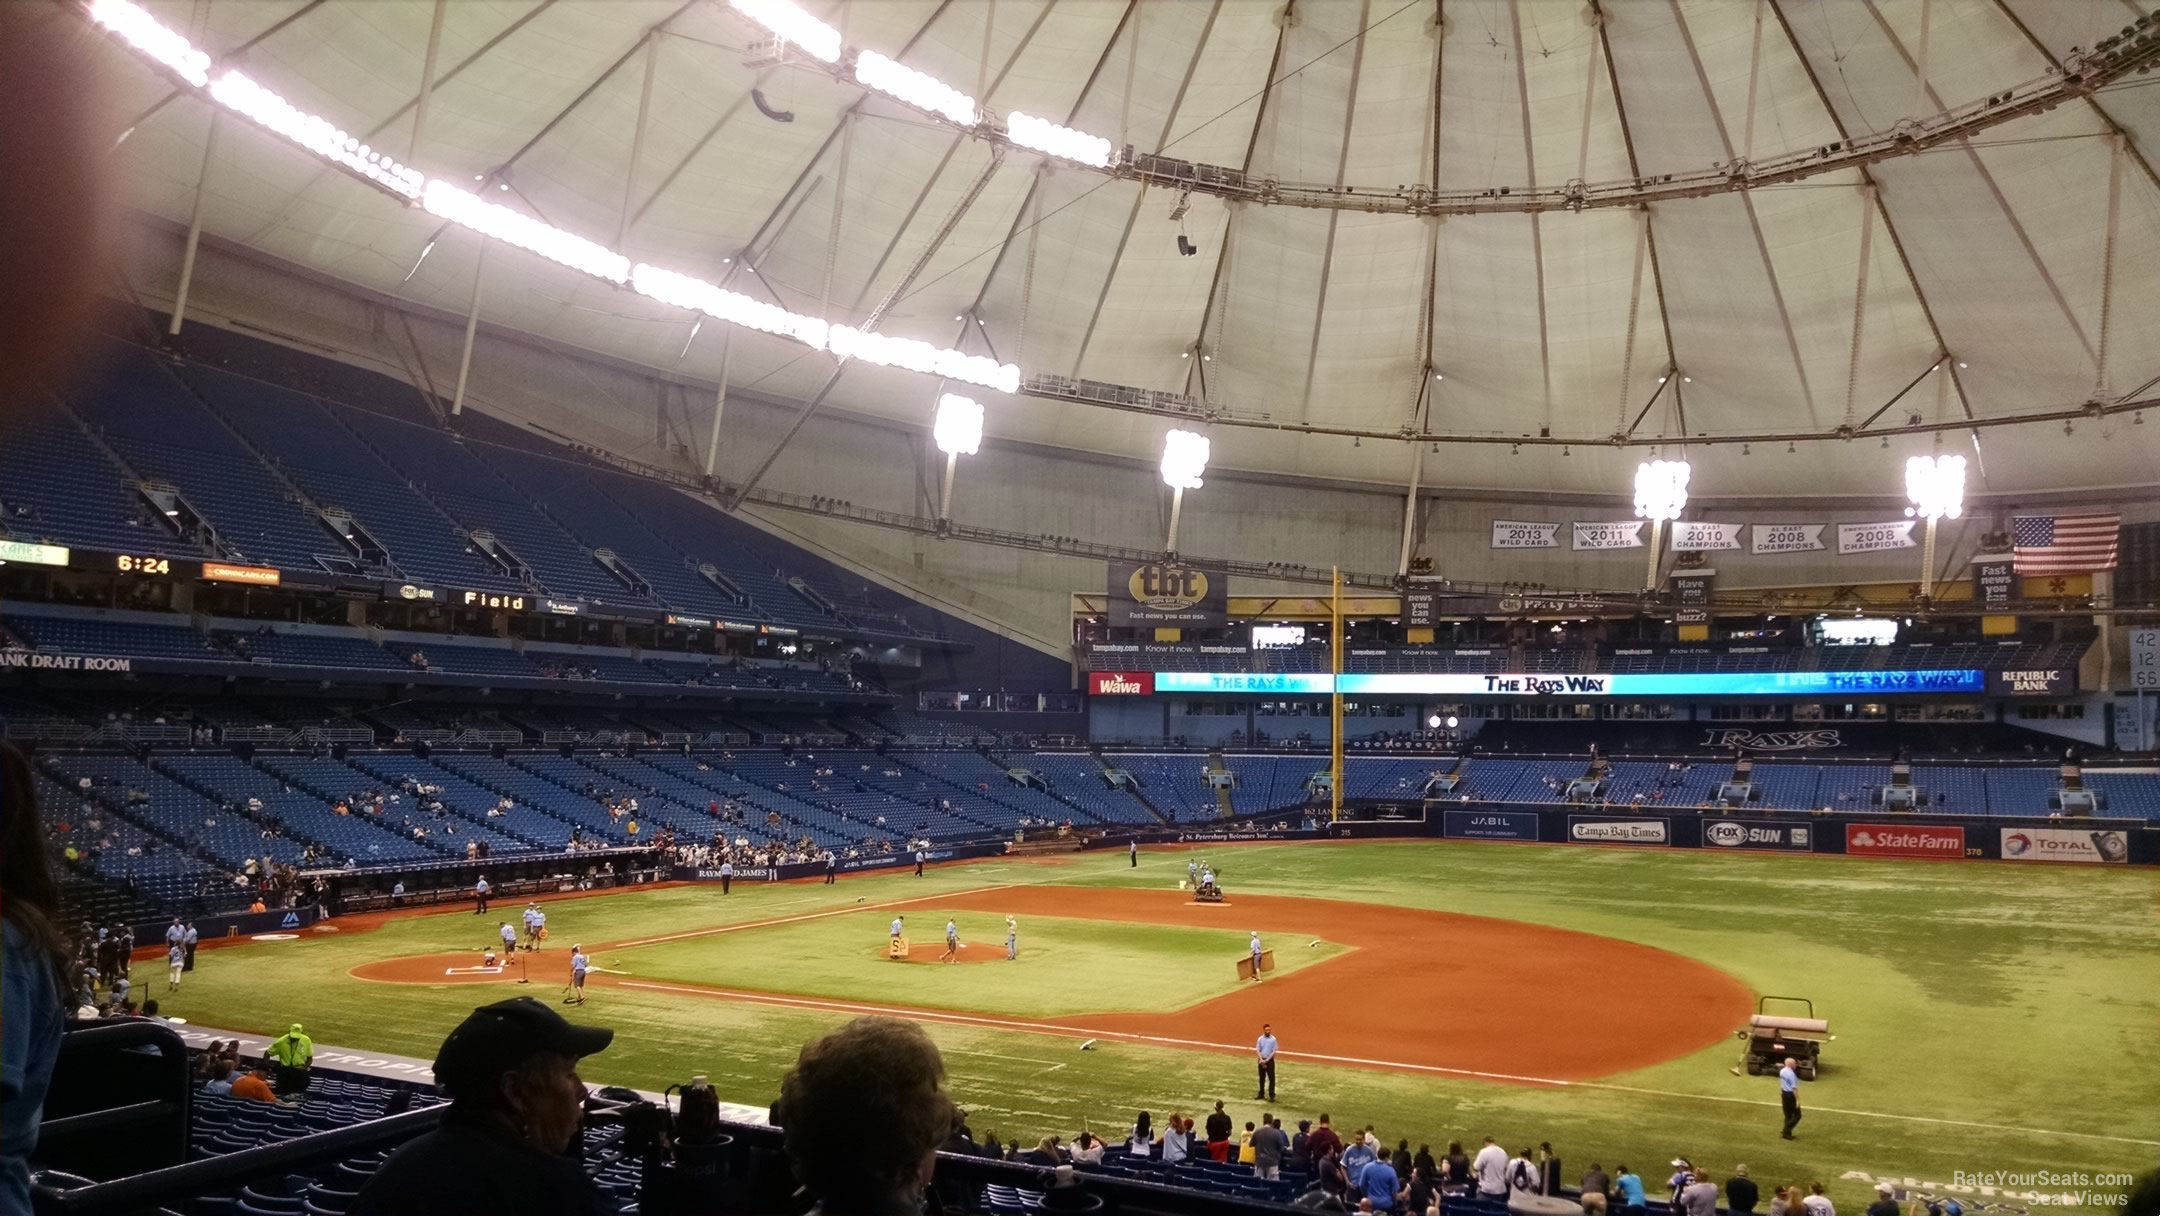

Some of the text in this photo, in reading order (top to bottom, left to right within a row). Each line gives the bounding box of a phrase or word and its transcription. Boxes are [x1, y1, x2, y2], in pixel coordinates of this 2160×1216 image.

[1509, 530, 1542, 540] 2013
[1591, 531, 1623, 540] 2011
[1687, 531, 1723, 541] 2010
[1768, 533, 1806, 543] 2008
[1855, 530, 1895, 543] 2008
[1844, 541, 1906, 550] CHAMPIONS
[118, 555, 170, 574] 6:24
[1982, 566, 2007, 575] Fast
[1140, 564, 1198, 597] tbt
[1678, 580, 1705, 588] Have
[1981, 576, 2012, 585] news
[419, 589, 434, 598] SUN
[1985, 585, 2008, 595] you
[465, 592, 523, 610] Field
[1411, 603, 1429, 611] you
[1676, 612, 1708, 622] buzz?
[2136, 633, 2156, 647] 42
[1093, 644, 1139, 652] tampabay.com
[1200, 645, 1247, 654] tampabay.com
[31, 655, 81, 669] DRAFT
[85, 658, 130, 671] ROOM
[2139, 652, 2154, 666] 12
[2002, 670, 2060, 681] REPUBLIC
[2136, 671, 2157, 685] 66
[1100, 679, 1140, 694] Wawa
[1213, 677, 1243, 689] THE
[1247, 677, 1285, 689] RAYS
[1485, 675, 1520, 691] THE
[1565, 676, 1605, 692] WAY
[1829, 675, 1962, 689] THE RAYS WAY
[2014, 681, 2048, 691] BANK
[1471, 817, 1510, 826] JABIL
[1576, 825, 1662, 839] Tampa Bay Times
[1716, 827, 1782, 843] FOX SUN
[2036, 838, 2092, 850] TOTAL
[699, 869, 767, 878] RAYMD JAMES
